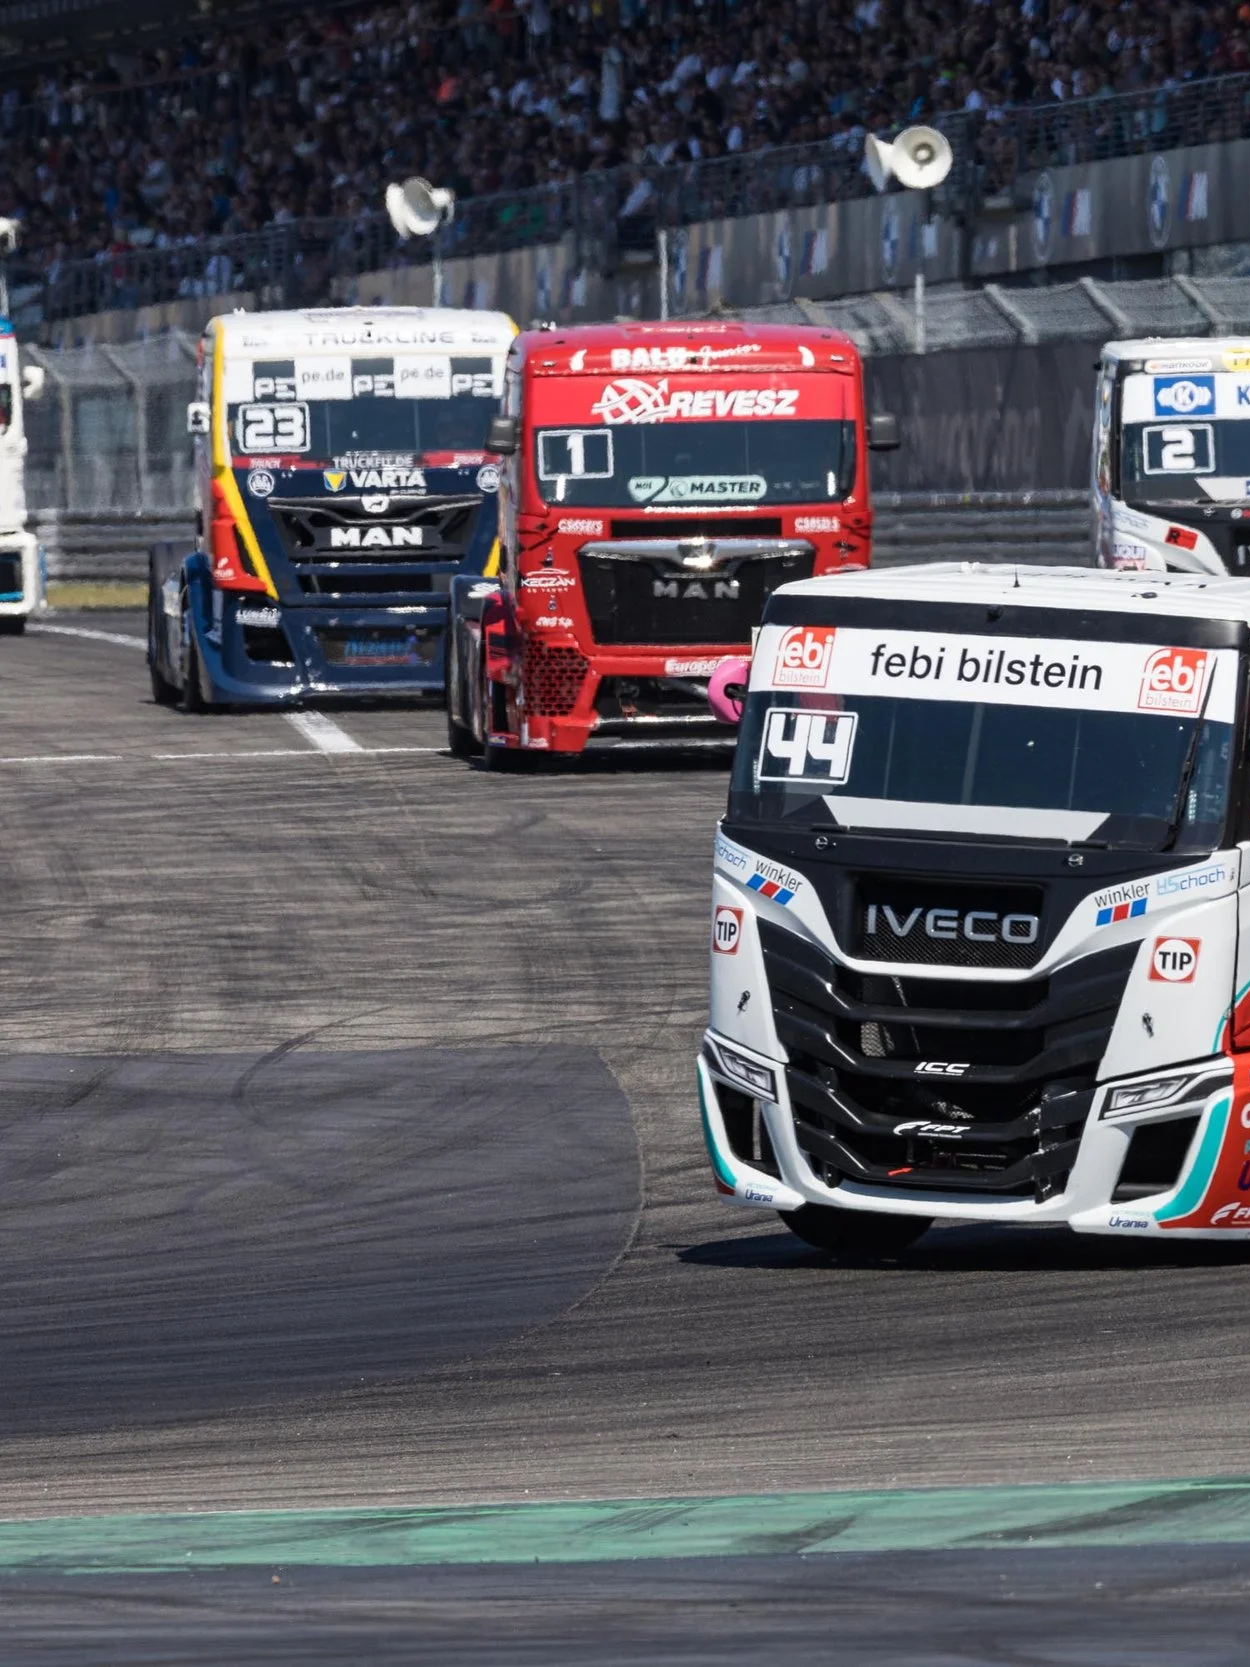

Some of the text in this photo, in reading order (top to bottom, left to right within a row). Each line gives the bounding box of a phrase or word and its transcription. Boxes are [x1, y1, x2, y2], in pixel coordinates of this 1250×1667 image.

[668, 390, 799, 417] REVESZ
[245, 406, 305, 448] 23
[567, 433, 584, 475] 1
[1161, 429, 1195, 470] 2
[350, 469, 427, 488] VARTA
[690, 481, 761, 493] MASTER
[331, 526, 423, 547] MAN
[653, 580, 740, 599] MAN
[870, 644, 1103, 690] febi bilstein
[778, 671, 821, 685] bilstein
[1144, 692, 1192, 709] bilstein
[767, 713, 853, 778] 44
[755, 858, 803, 892] winkler
[1095, 883, 1150, 908] winkler
[717, 921, 737, 942] TIP
[867, 904, 1039, 944] IVECO
[1158, 951, 1192, 971] TIP
[916, 1062, 970, 1073] ICC
[920, 1124, 971, 1133] FPT
[745, 1189, 773, 1202] Urania
[1108, 1216, 1149, 1228] Urania
